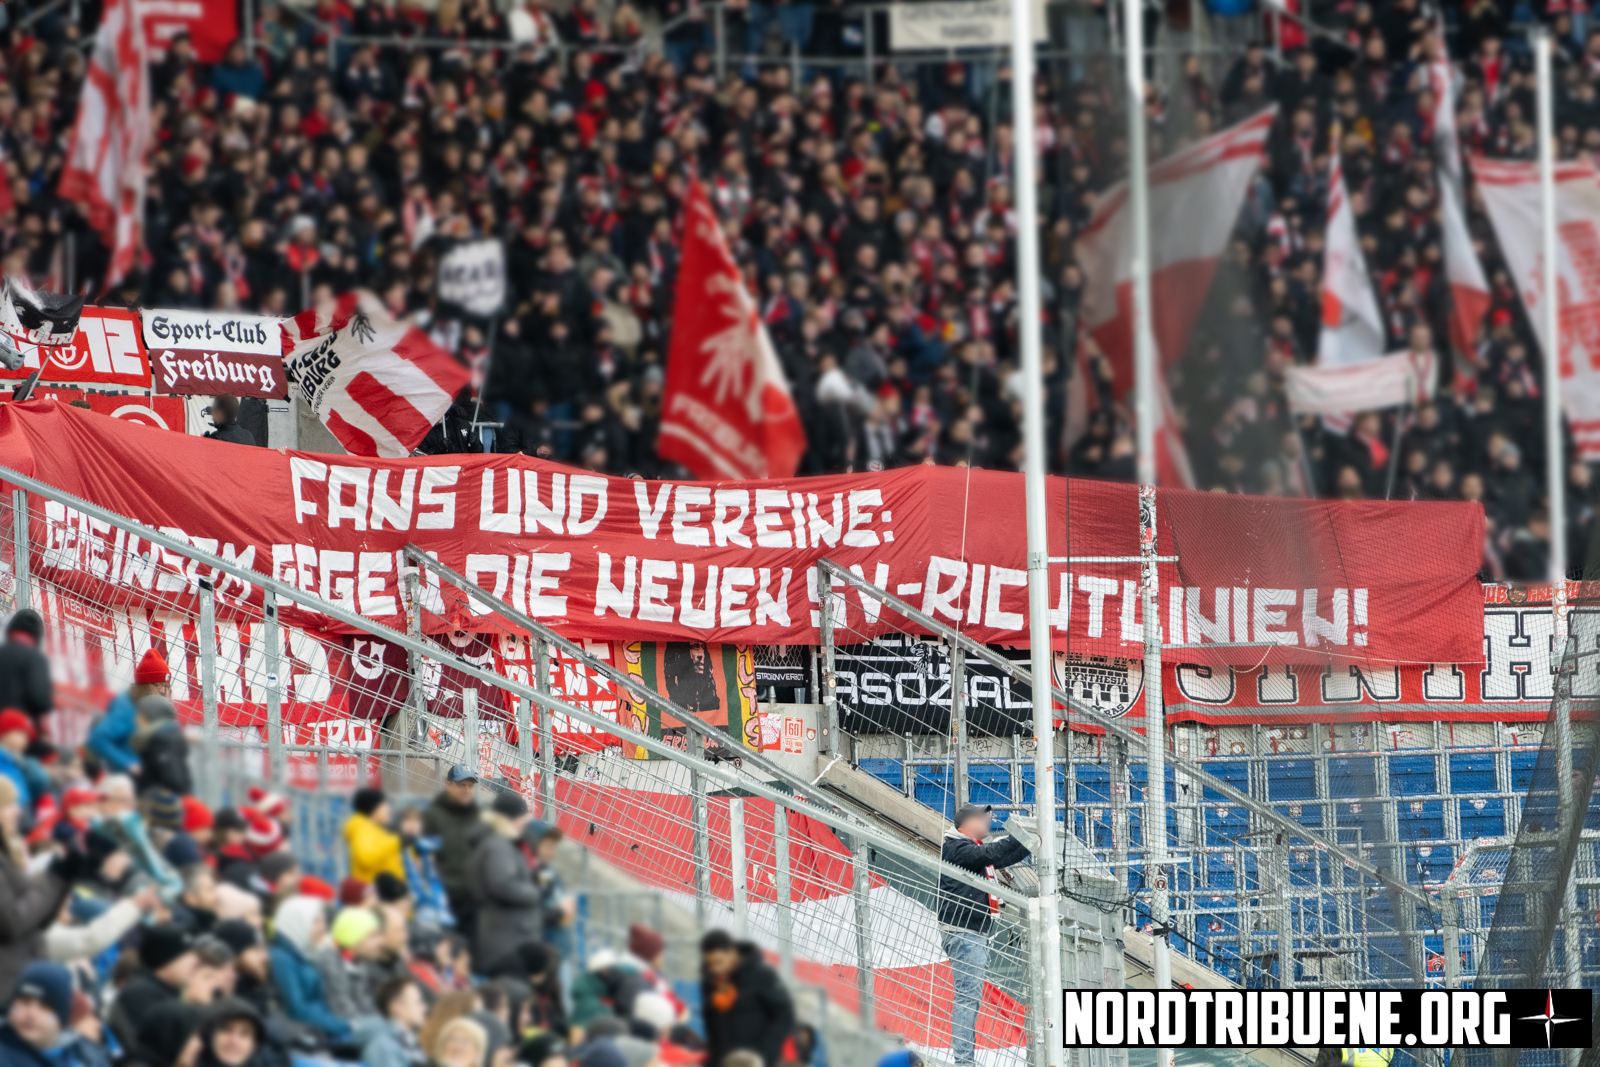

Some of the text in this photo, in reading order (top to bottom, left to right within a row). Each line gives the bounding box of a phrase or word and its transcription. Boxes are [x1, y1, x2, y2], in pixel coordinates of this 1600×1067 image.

[151, 315, 268, 345] Sport-Club
[161, 350, 277, 393] Freiburg
[290, 456, 894, 549] FANS UND VEREINE:
[272, 543, 446, 617] GEGEN
[466, 552, 571, 617] DIE
[594, 552, 793, 629] NEUEN
[1065, 672, 1128, 686] SYNTHESIA
